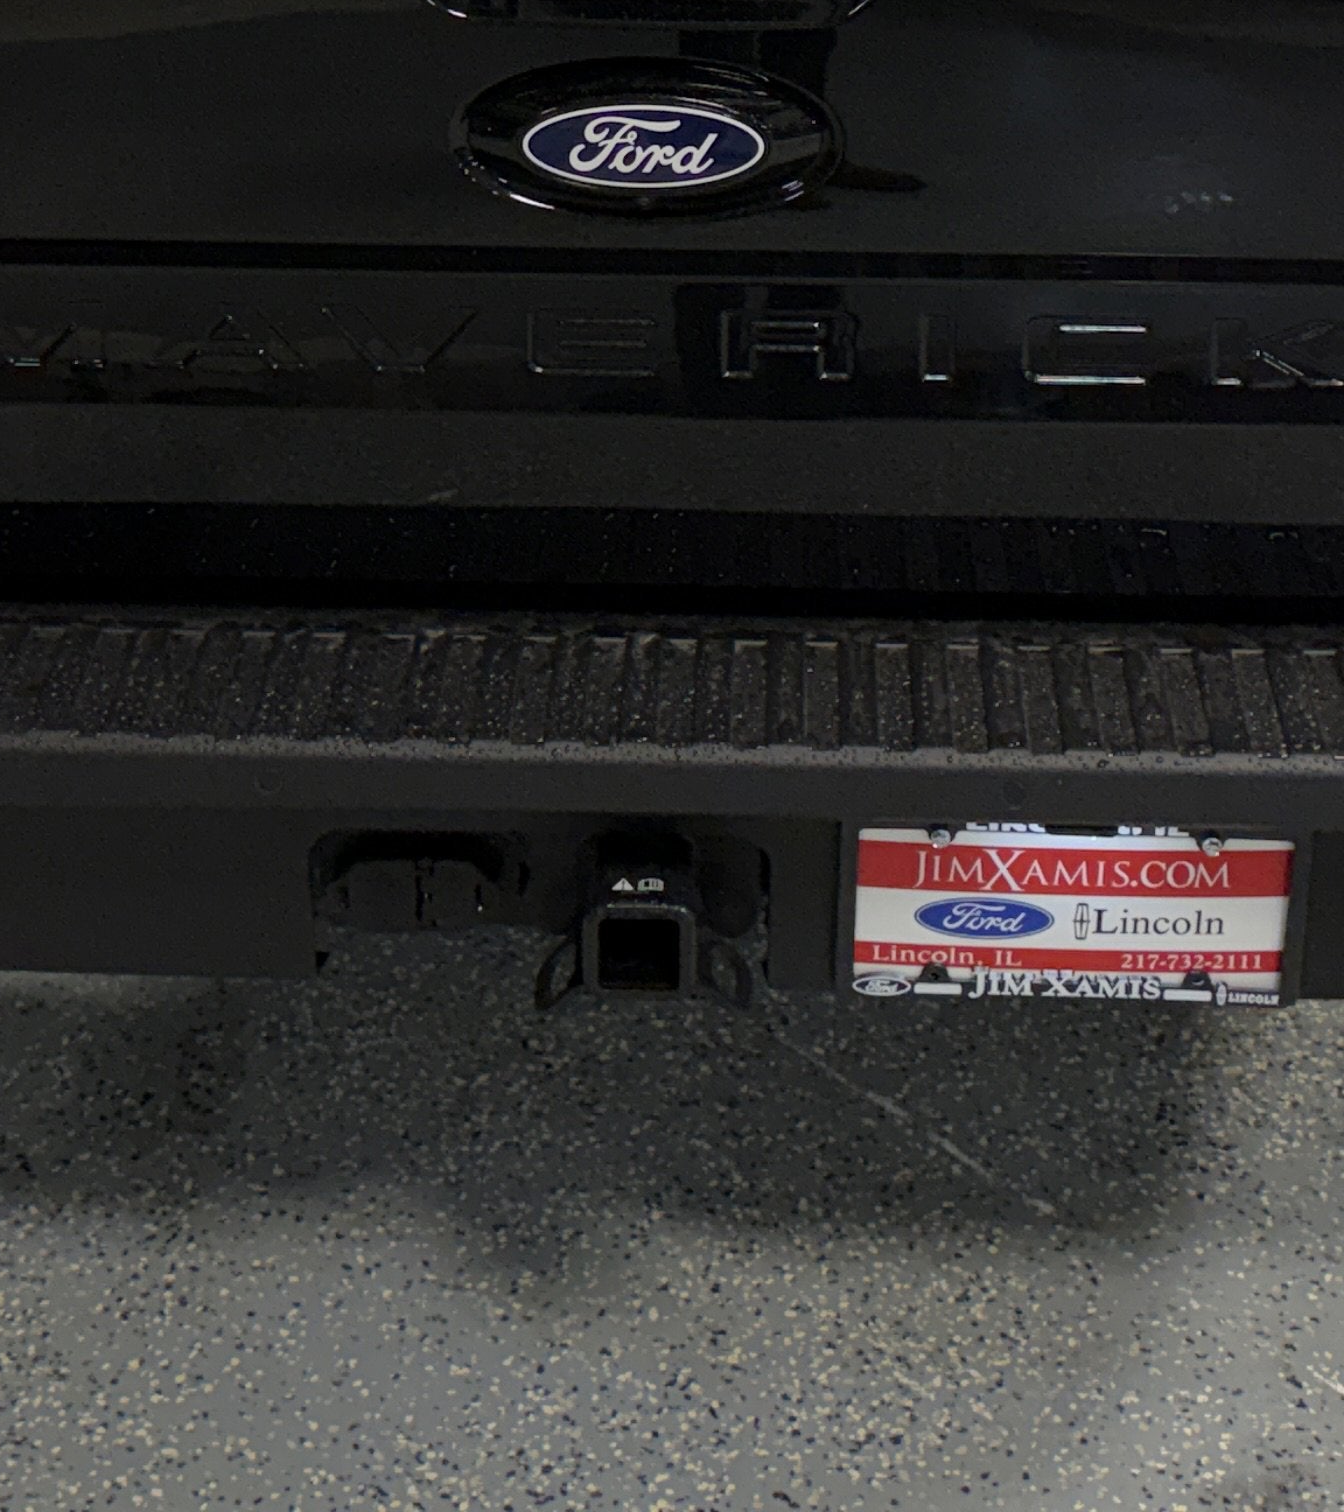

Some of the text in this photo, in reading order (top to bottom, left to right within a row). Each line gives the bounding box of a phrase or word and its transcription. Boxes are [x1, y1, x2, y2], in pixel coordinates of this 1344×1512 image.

[568, 115, 718, 175] Ford
[942, 901, 1226, 936] Ford Lincoln
[994, 949, 1023, 967] IL
[1120, 953, 1263, 971] 217-732-2111
[967, 967, 1162, 1000] JIM XAMIS
[1227, 991, 1281, 1006] LINCOLN
